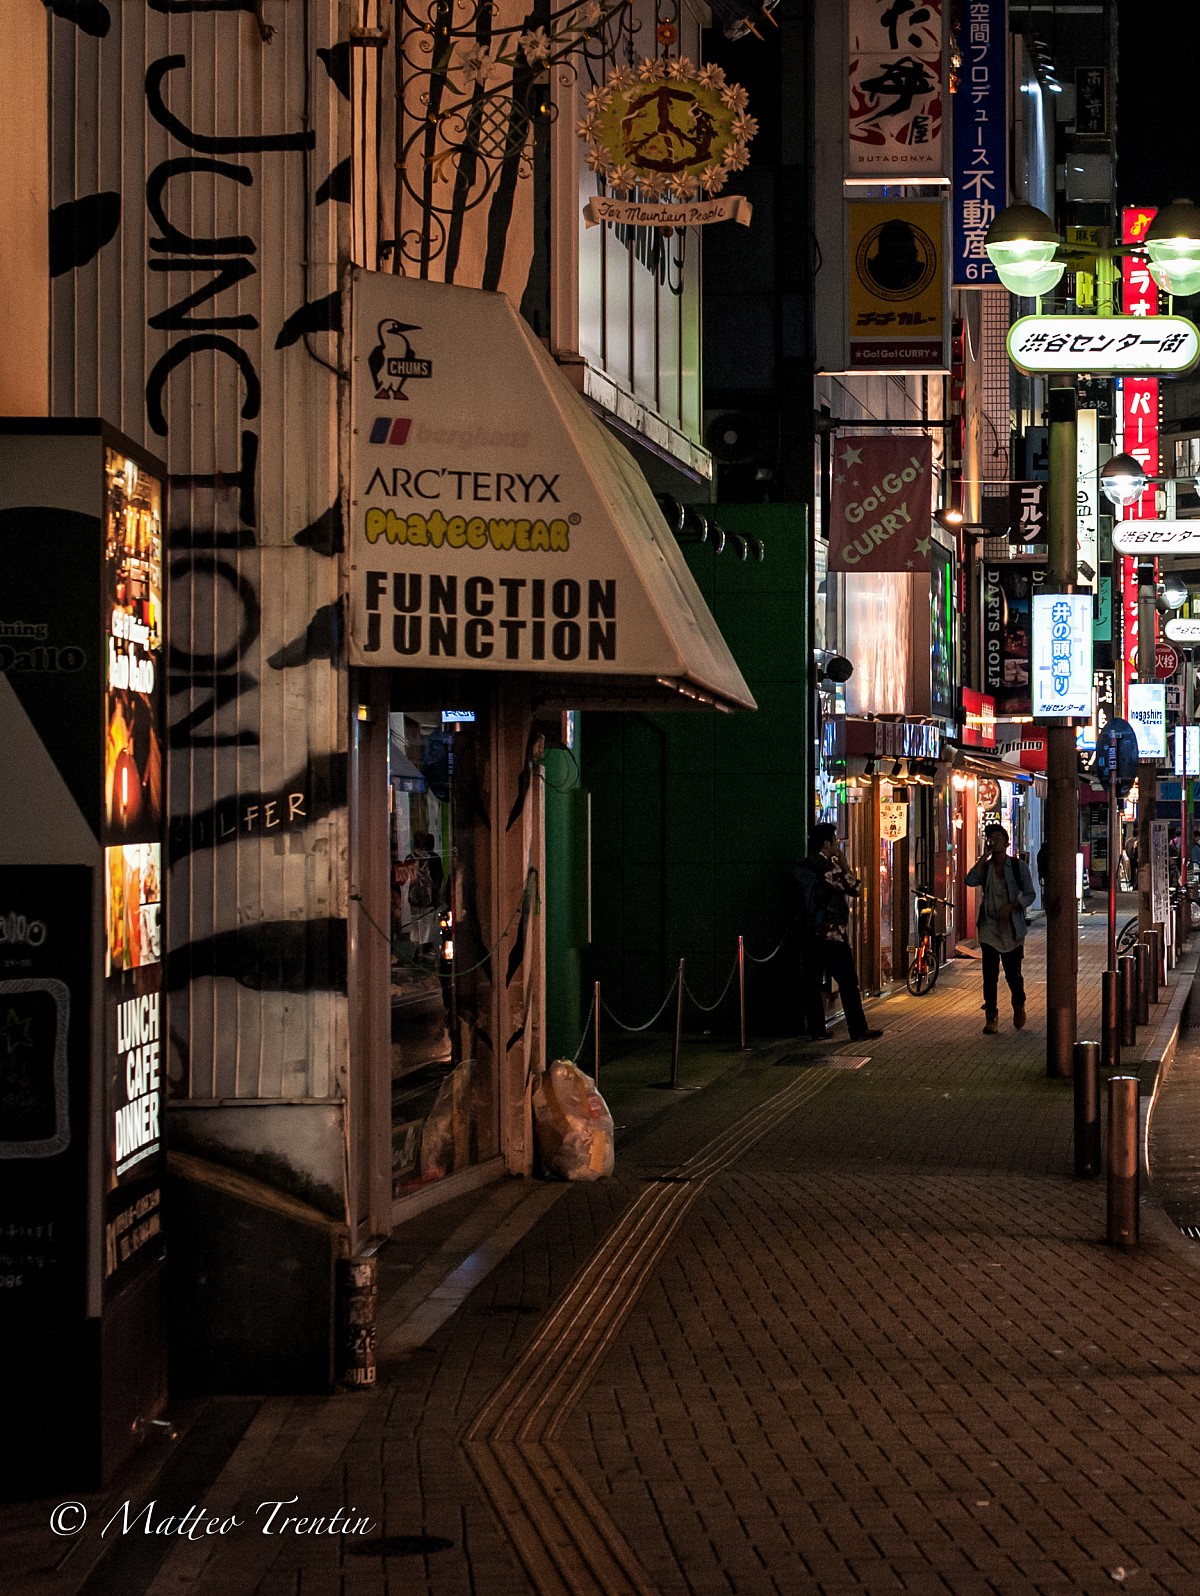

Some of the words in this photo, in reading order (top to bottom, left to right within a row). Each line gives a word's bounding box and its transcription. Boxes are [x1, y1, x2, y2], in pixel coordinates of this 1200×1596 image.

[598, 202, 621, 218] For
[625, 207, 687, 222] Mountain
[689, 206, 725, 223] People
[390, 361, 428, 376] CHUMS
[1018, 333, 1189, 353] 渋谷センター街
[145, 55, 315, 748] JUNCTION
[365, 466, 560, 502] ARC'TERYX
[841, 503, 911, 564] CURRY
[365, 571, 616, 619] FUNCTION
[988, 571, 999, 631] DARTS
[364, 613, 616, 661] JUNCTION
[1052, 602, 1071, 696] 井の頭通り
[988, 641, 999, 688] GOLF
[117, 992, 160, 1054] LUNCH
[127, 1041, 160, 1100] CAFE
[115, 1091, 160, 1161] DINNER
